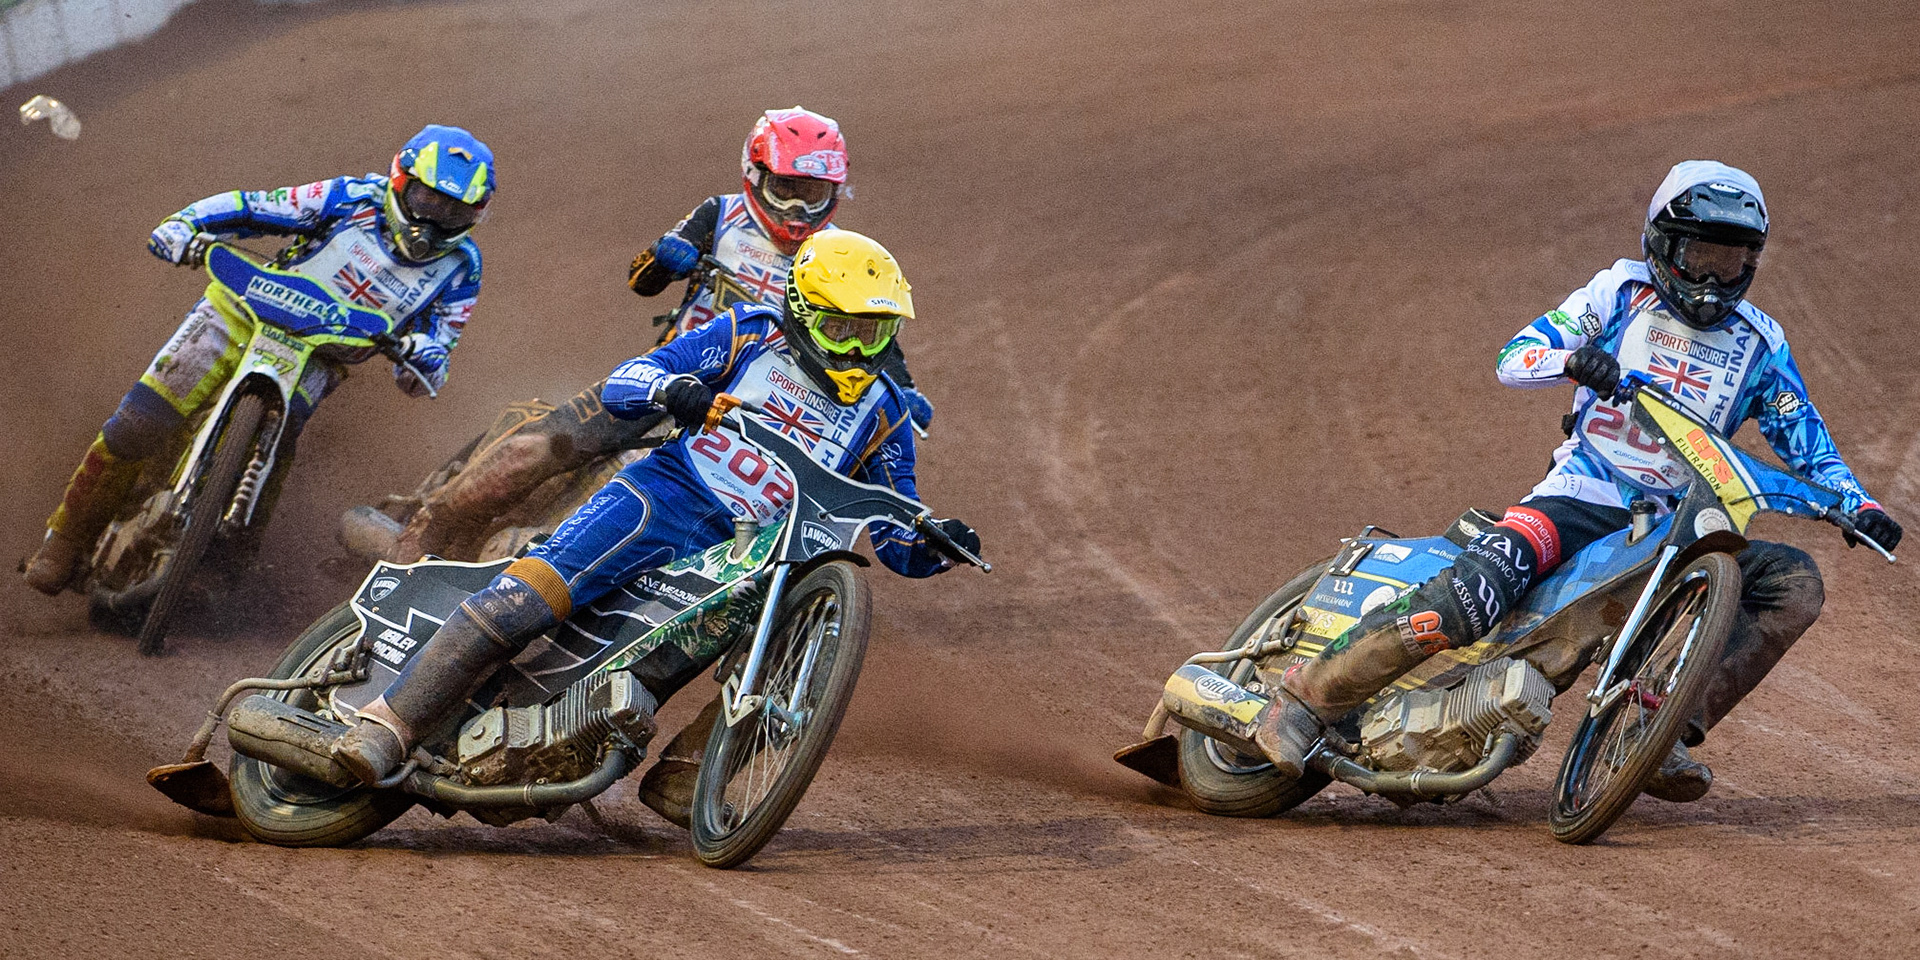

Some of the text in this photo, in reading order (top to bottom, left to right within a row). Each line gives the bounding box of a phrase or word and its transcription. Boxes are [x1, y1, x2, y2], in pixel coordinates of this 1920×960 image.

[351, 243, 381, 275] SPORTS
[738, 243, 774, 266] SPORTS
[396, 268, 439, 314] FINAL
[1648, 329, 1727, 367] SPORTS INSURE
[1724, 326, 1751, 388] FINAL
[769, 370, 839, 422] SPORTS INSURE
[831, 398, 865, 445] FINA
[691, 430, 795, 508] 202
[1675, 437, 1721, 491] FILTRATION
[567, 515, 588, 526] &
[803, 526, 841, 550] LAWSON
[638, 575, 660, 589] AVE
